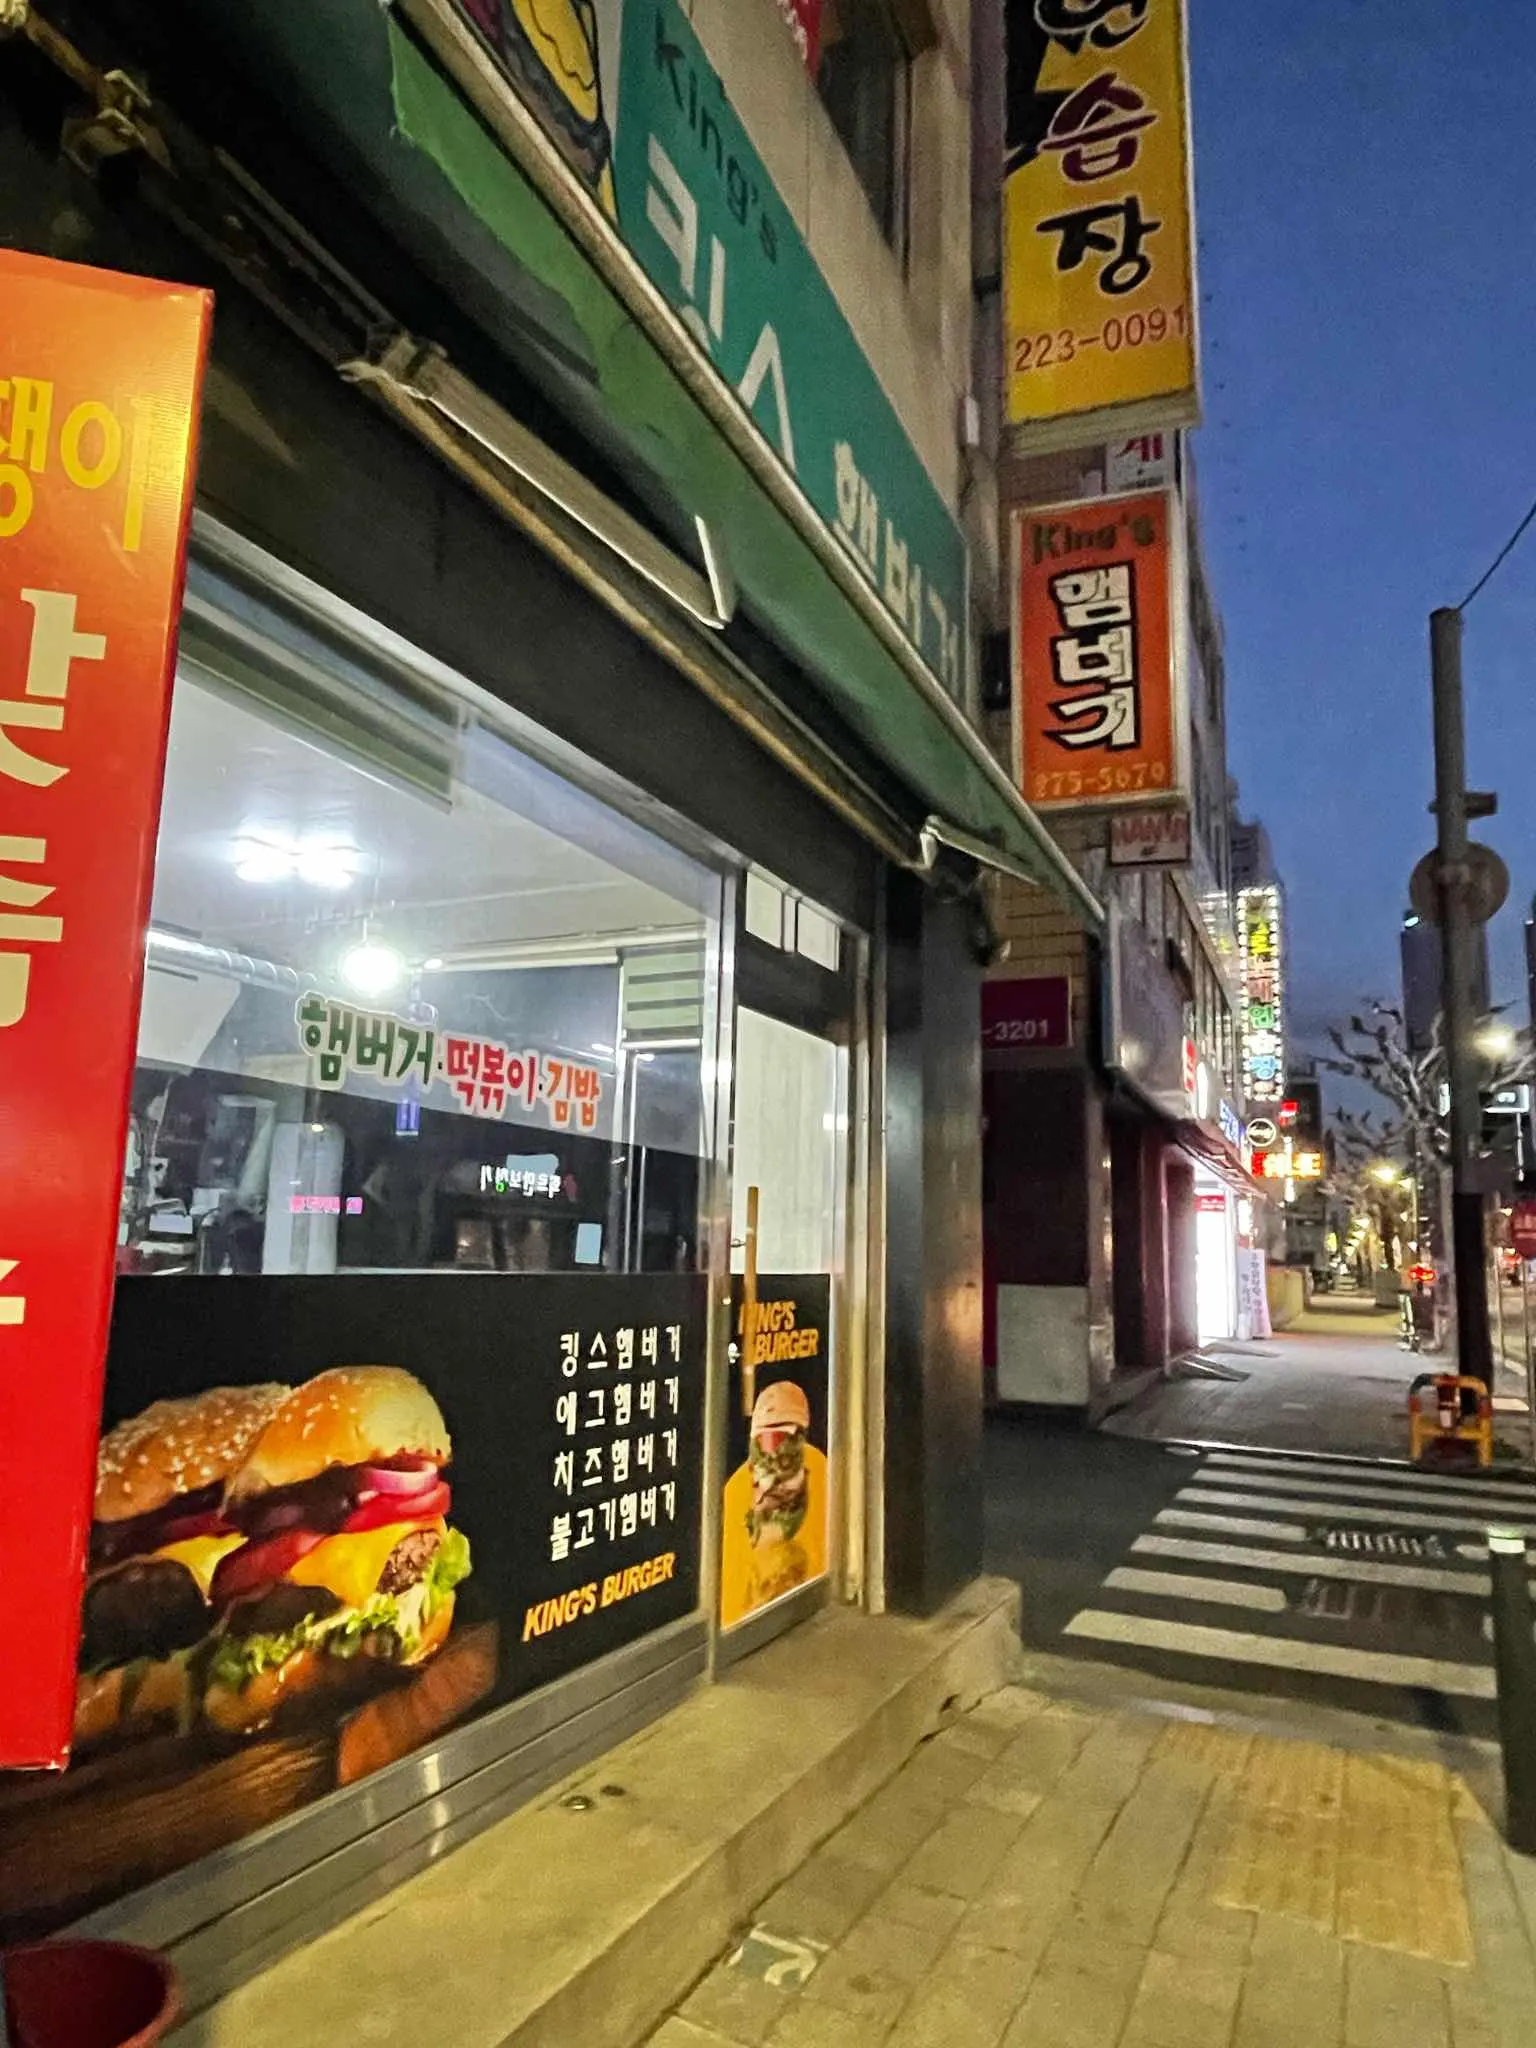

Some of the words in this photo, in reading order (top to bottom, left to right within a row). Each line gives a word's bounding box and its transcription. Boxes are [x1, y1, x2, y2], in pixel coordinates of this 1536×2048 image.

[653, 6, 778, 266] King's
[1014, 303, 1186, 372] 223-0091
[1046, 562, 1138, 750] 햄버거
[300, 997, 436, 1085] 햄버거
[446, 1036, 537, 1113] 떡볶이
[546, 1060, 600, 1127] 김밥
[560, 1325, 681, 1378] 킹스햄버거
[754, 1328, 819, 1365] BURGER
[556, 1376, 679, 1436] 에그햄버거
[553, 1427, 677, 1496] 치즈햄버거
[549, 1481, 676, 1562] 불고기햄버거
[522, 1581, 598, 1643] KING'S
[599, 1551, 676, 1609] BURGER
